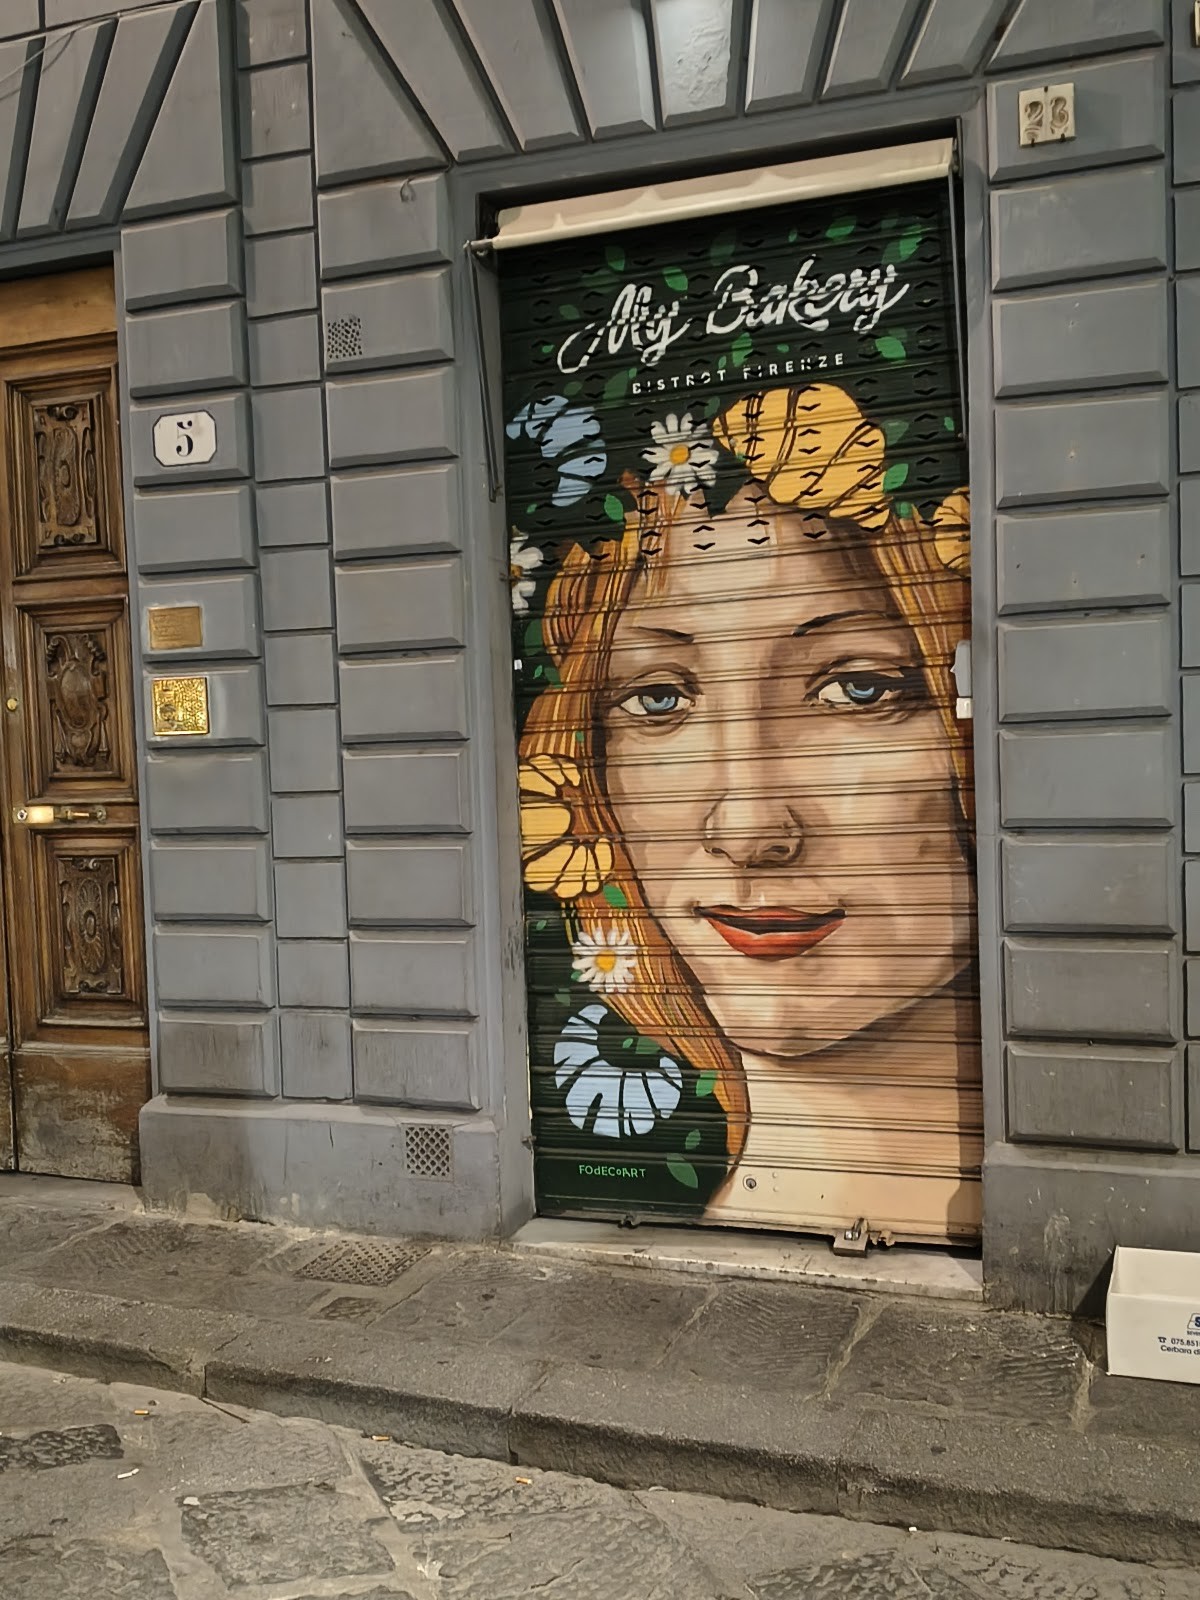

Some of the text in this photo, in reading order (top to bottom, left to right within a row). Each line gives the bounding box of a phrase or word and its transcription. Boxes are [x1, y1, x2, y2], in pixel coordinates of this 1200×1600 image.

[557, 253, 910, 374] My Bakery
[176, 420, 194, 457] 5
[1160, 1345, 1192, 1355] Cerbara
[1170, 1337, 1200, 1347] 075.851
